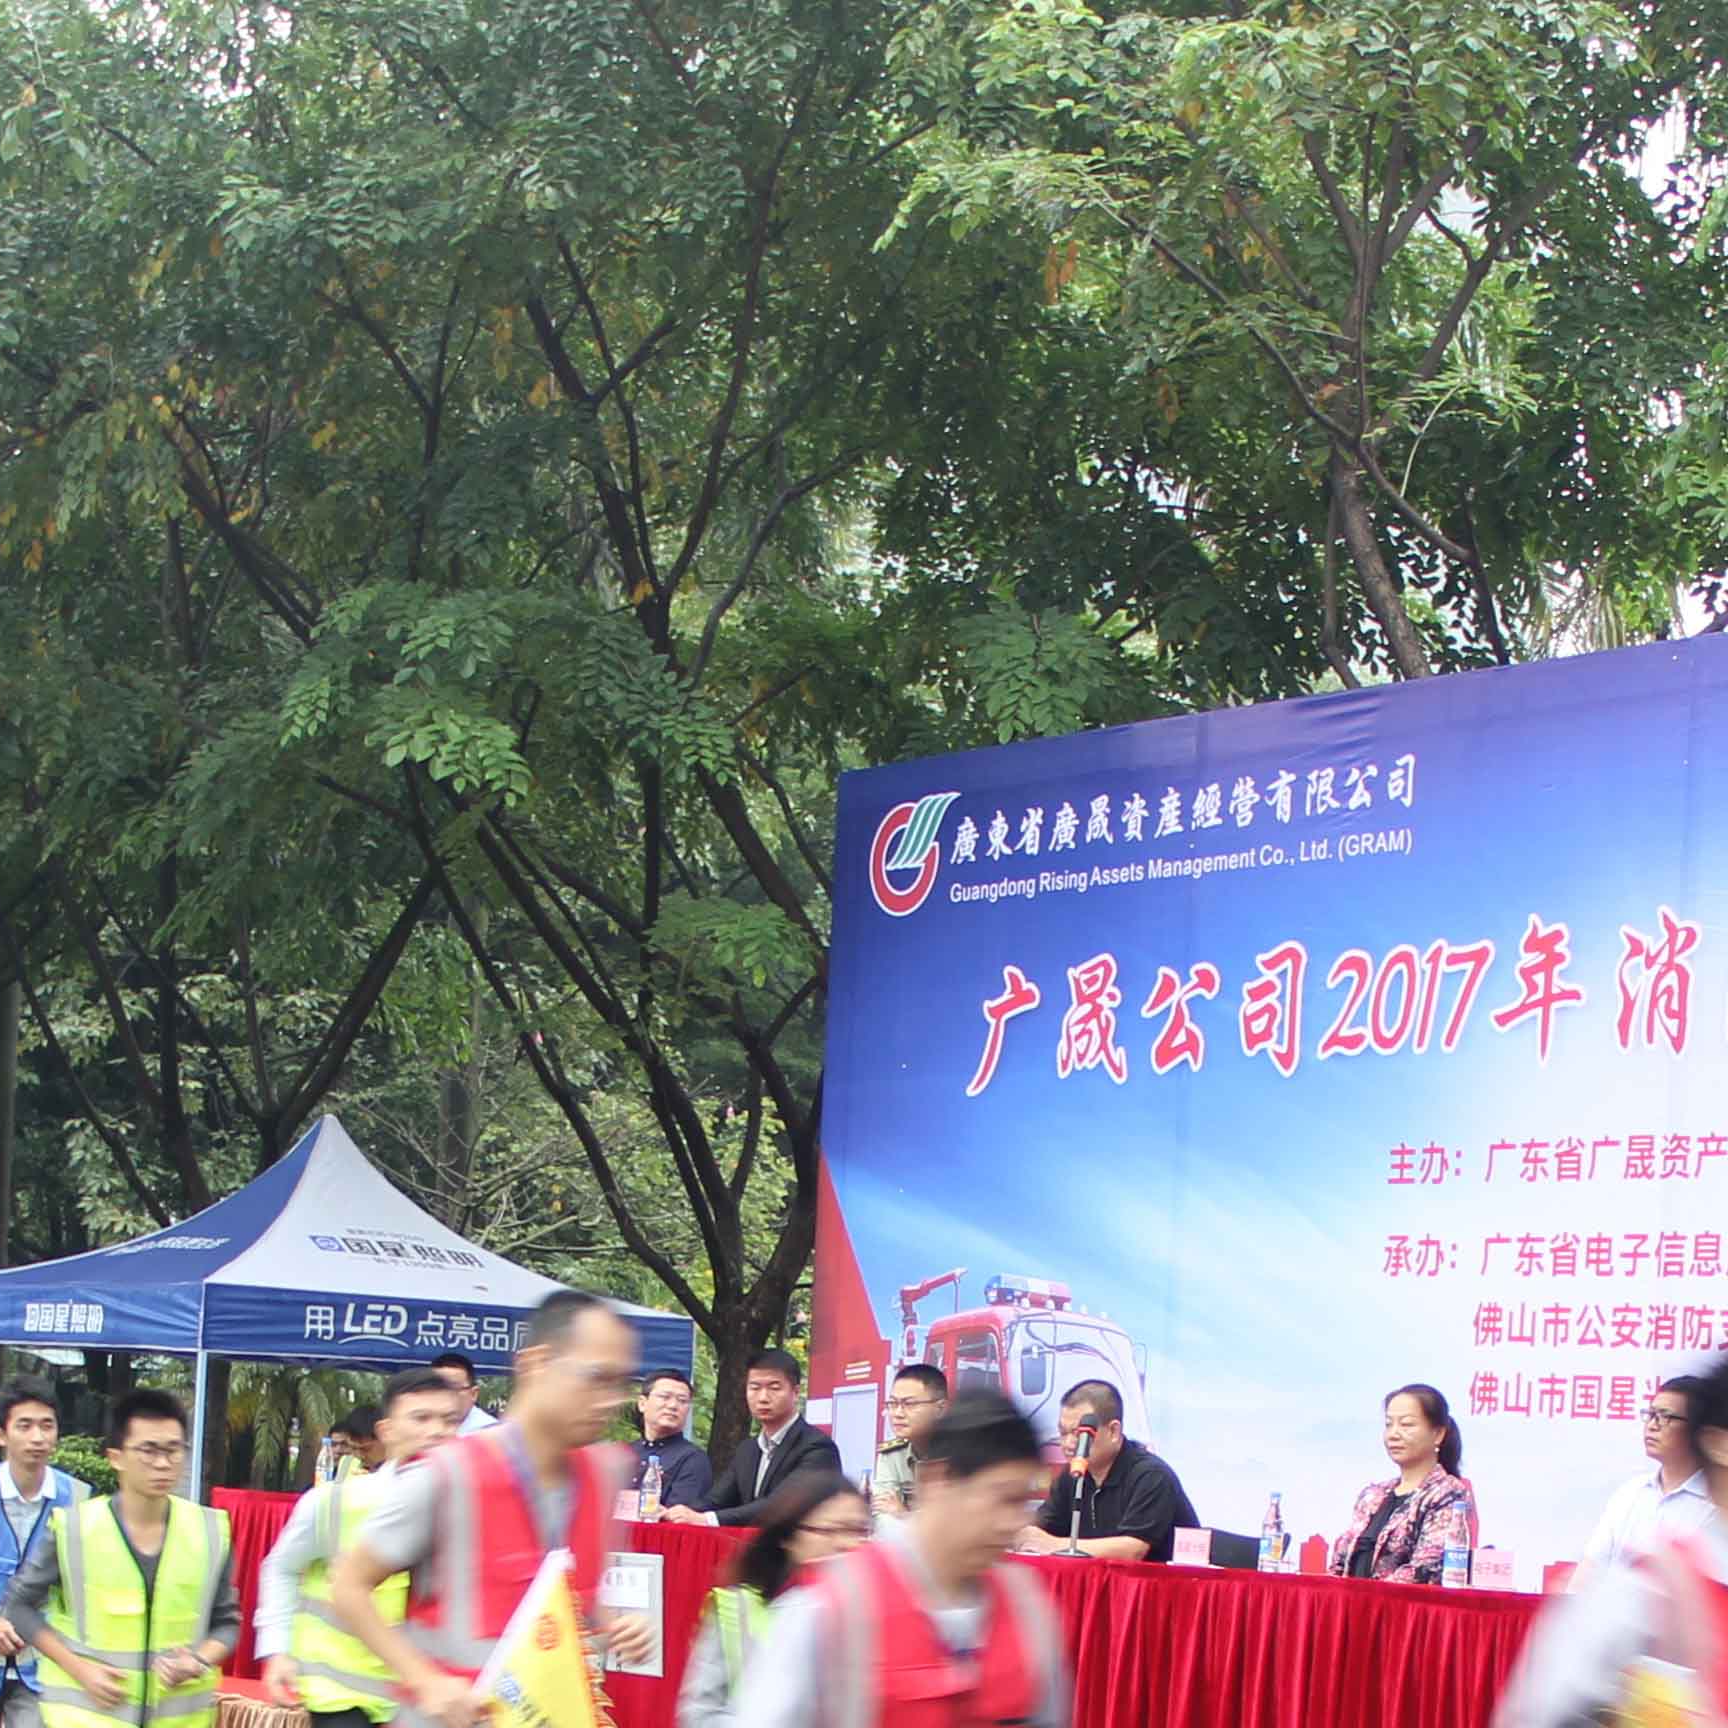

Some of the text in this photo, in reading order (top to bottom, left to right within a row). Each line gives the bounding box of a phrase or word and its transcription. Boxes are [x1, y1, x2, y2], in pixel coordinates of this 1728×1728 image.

[950, 828, 1413, 902] Guangdong Rising Assets Management Co., Ltd. (GRAM)
